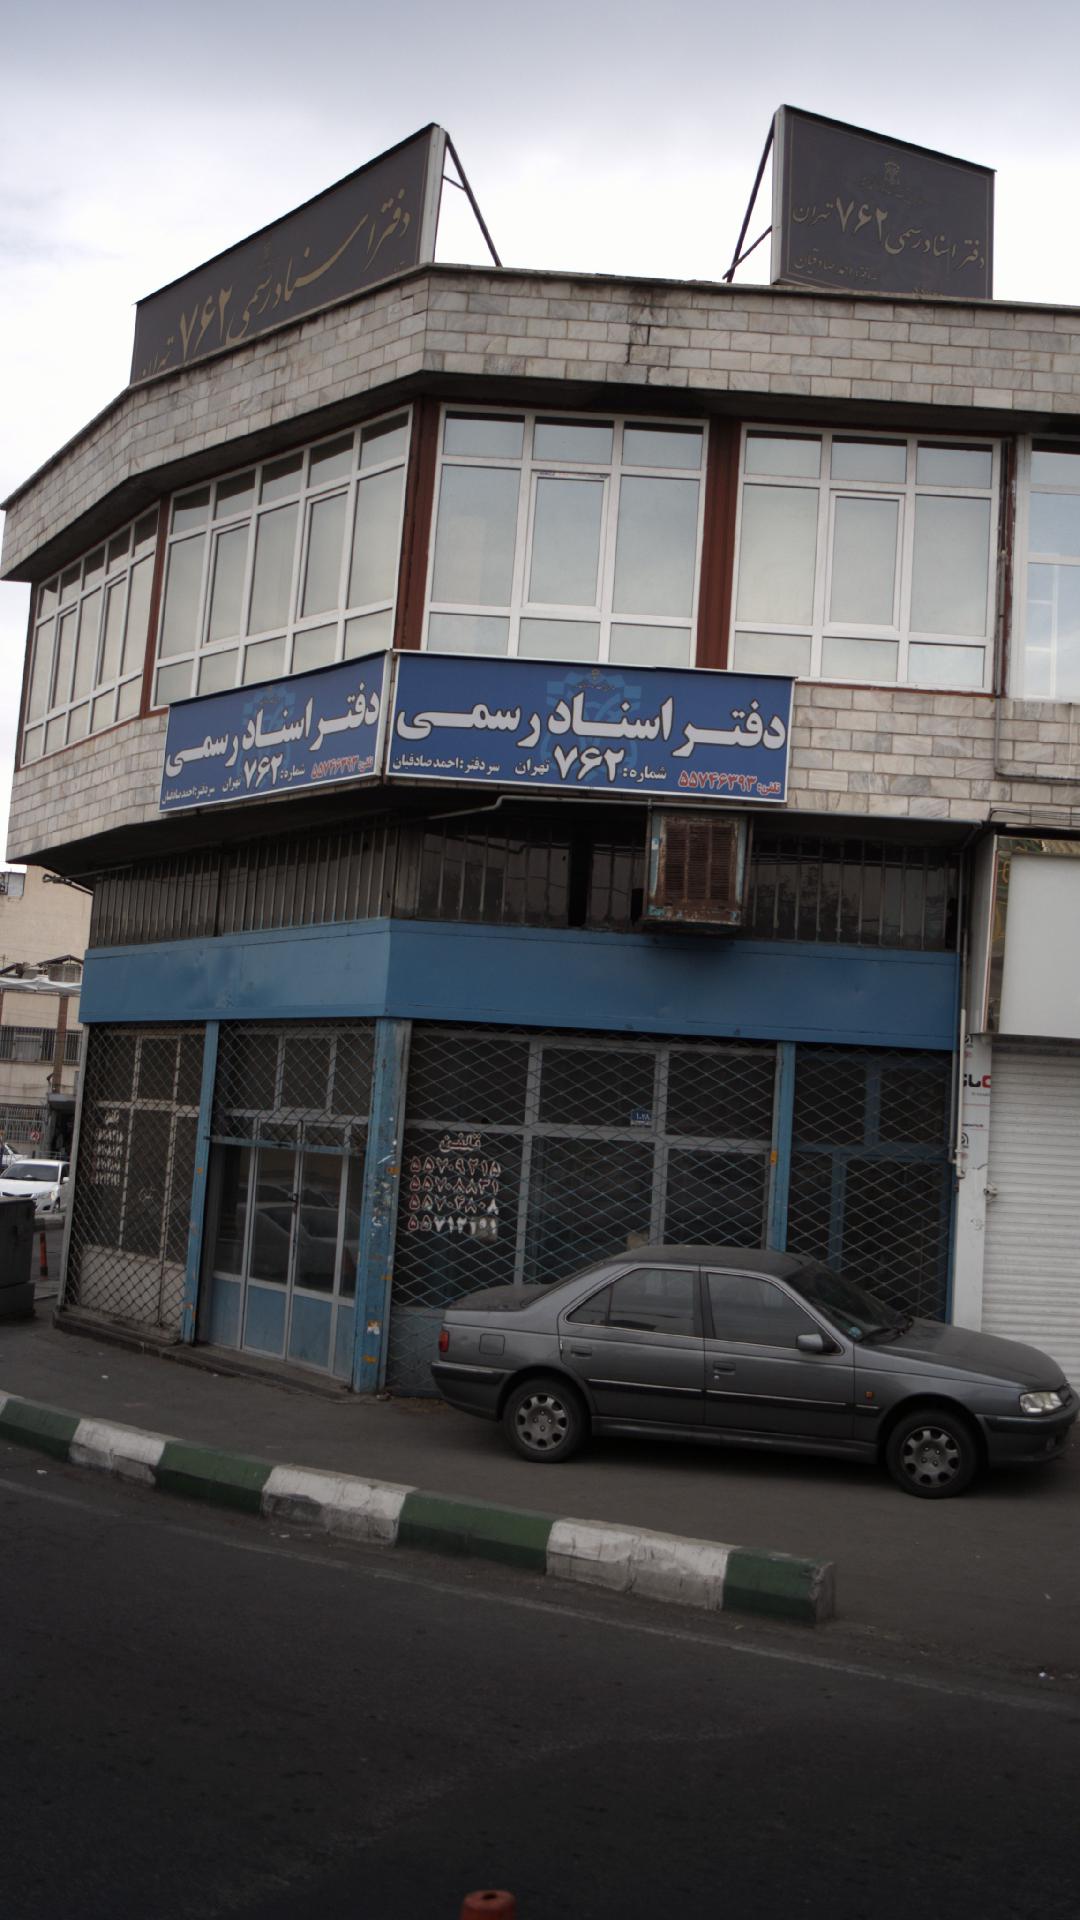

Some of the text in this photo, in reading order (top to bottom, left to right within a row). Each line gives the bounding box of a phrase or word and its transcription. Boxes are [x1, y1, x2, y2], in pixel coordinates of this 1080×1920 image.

[792, 203, 833, 225] تهران
[836, 196, 889, 241] ۷۶۲
[958, 240, 985, 270] دفتر
[179, 285, 233, 361] ۷۶۲
[165, 682, 380, 777] دفتر اسناد رسمی
[396, 691, 787, 758] دفتر اسناد رسمی
[243, 753, 284, 789] ۷۶۲
[392, 753, 433, 770] صادقیان
[434, 757, 459, 769] احمد
[514, 757, 550, 776] تهران
[554, 744, 625, 782] ۷۶۲
[678, 769, 757, 792] ۵۵۷۴۶۳۹۳
